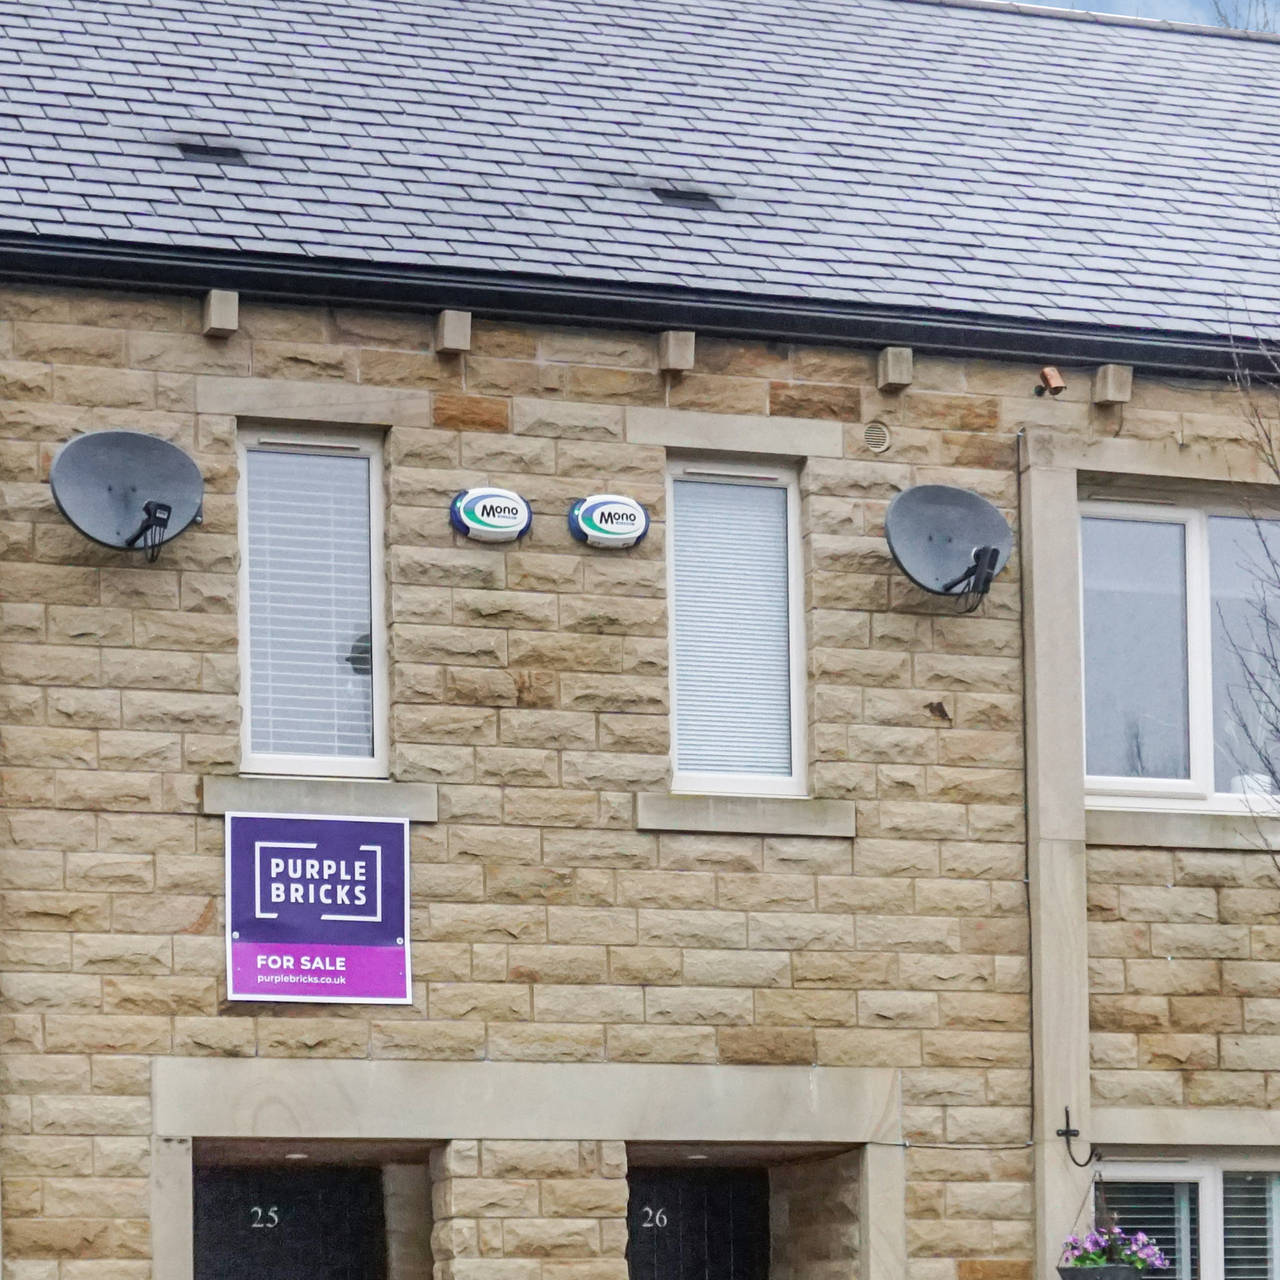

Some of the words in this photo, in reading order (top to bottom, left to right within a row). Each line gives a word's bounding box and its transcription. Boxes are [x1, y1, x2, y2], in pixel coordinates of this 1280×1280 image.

[481, 504, 518, 518] Mono
[599, 511, 636, 524] Mono
[270, 858, 367, 881] PURPLE
[271, 883, 367, 905] BRICKS
[257, 955, 294, 969] FOR
[300, 956, 346, 971] SALE
[257, 974, 346, 984] purplebricks.co.uk
[250, 1206, 278, 1228] 25
[642, 1206, 668, 1227] 26
